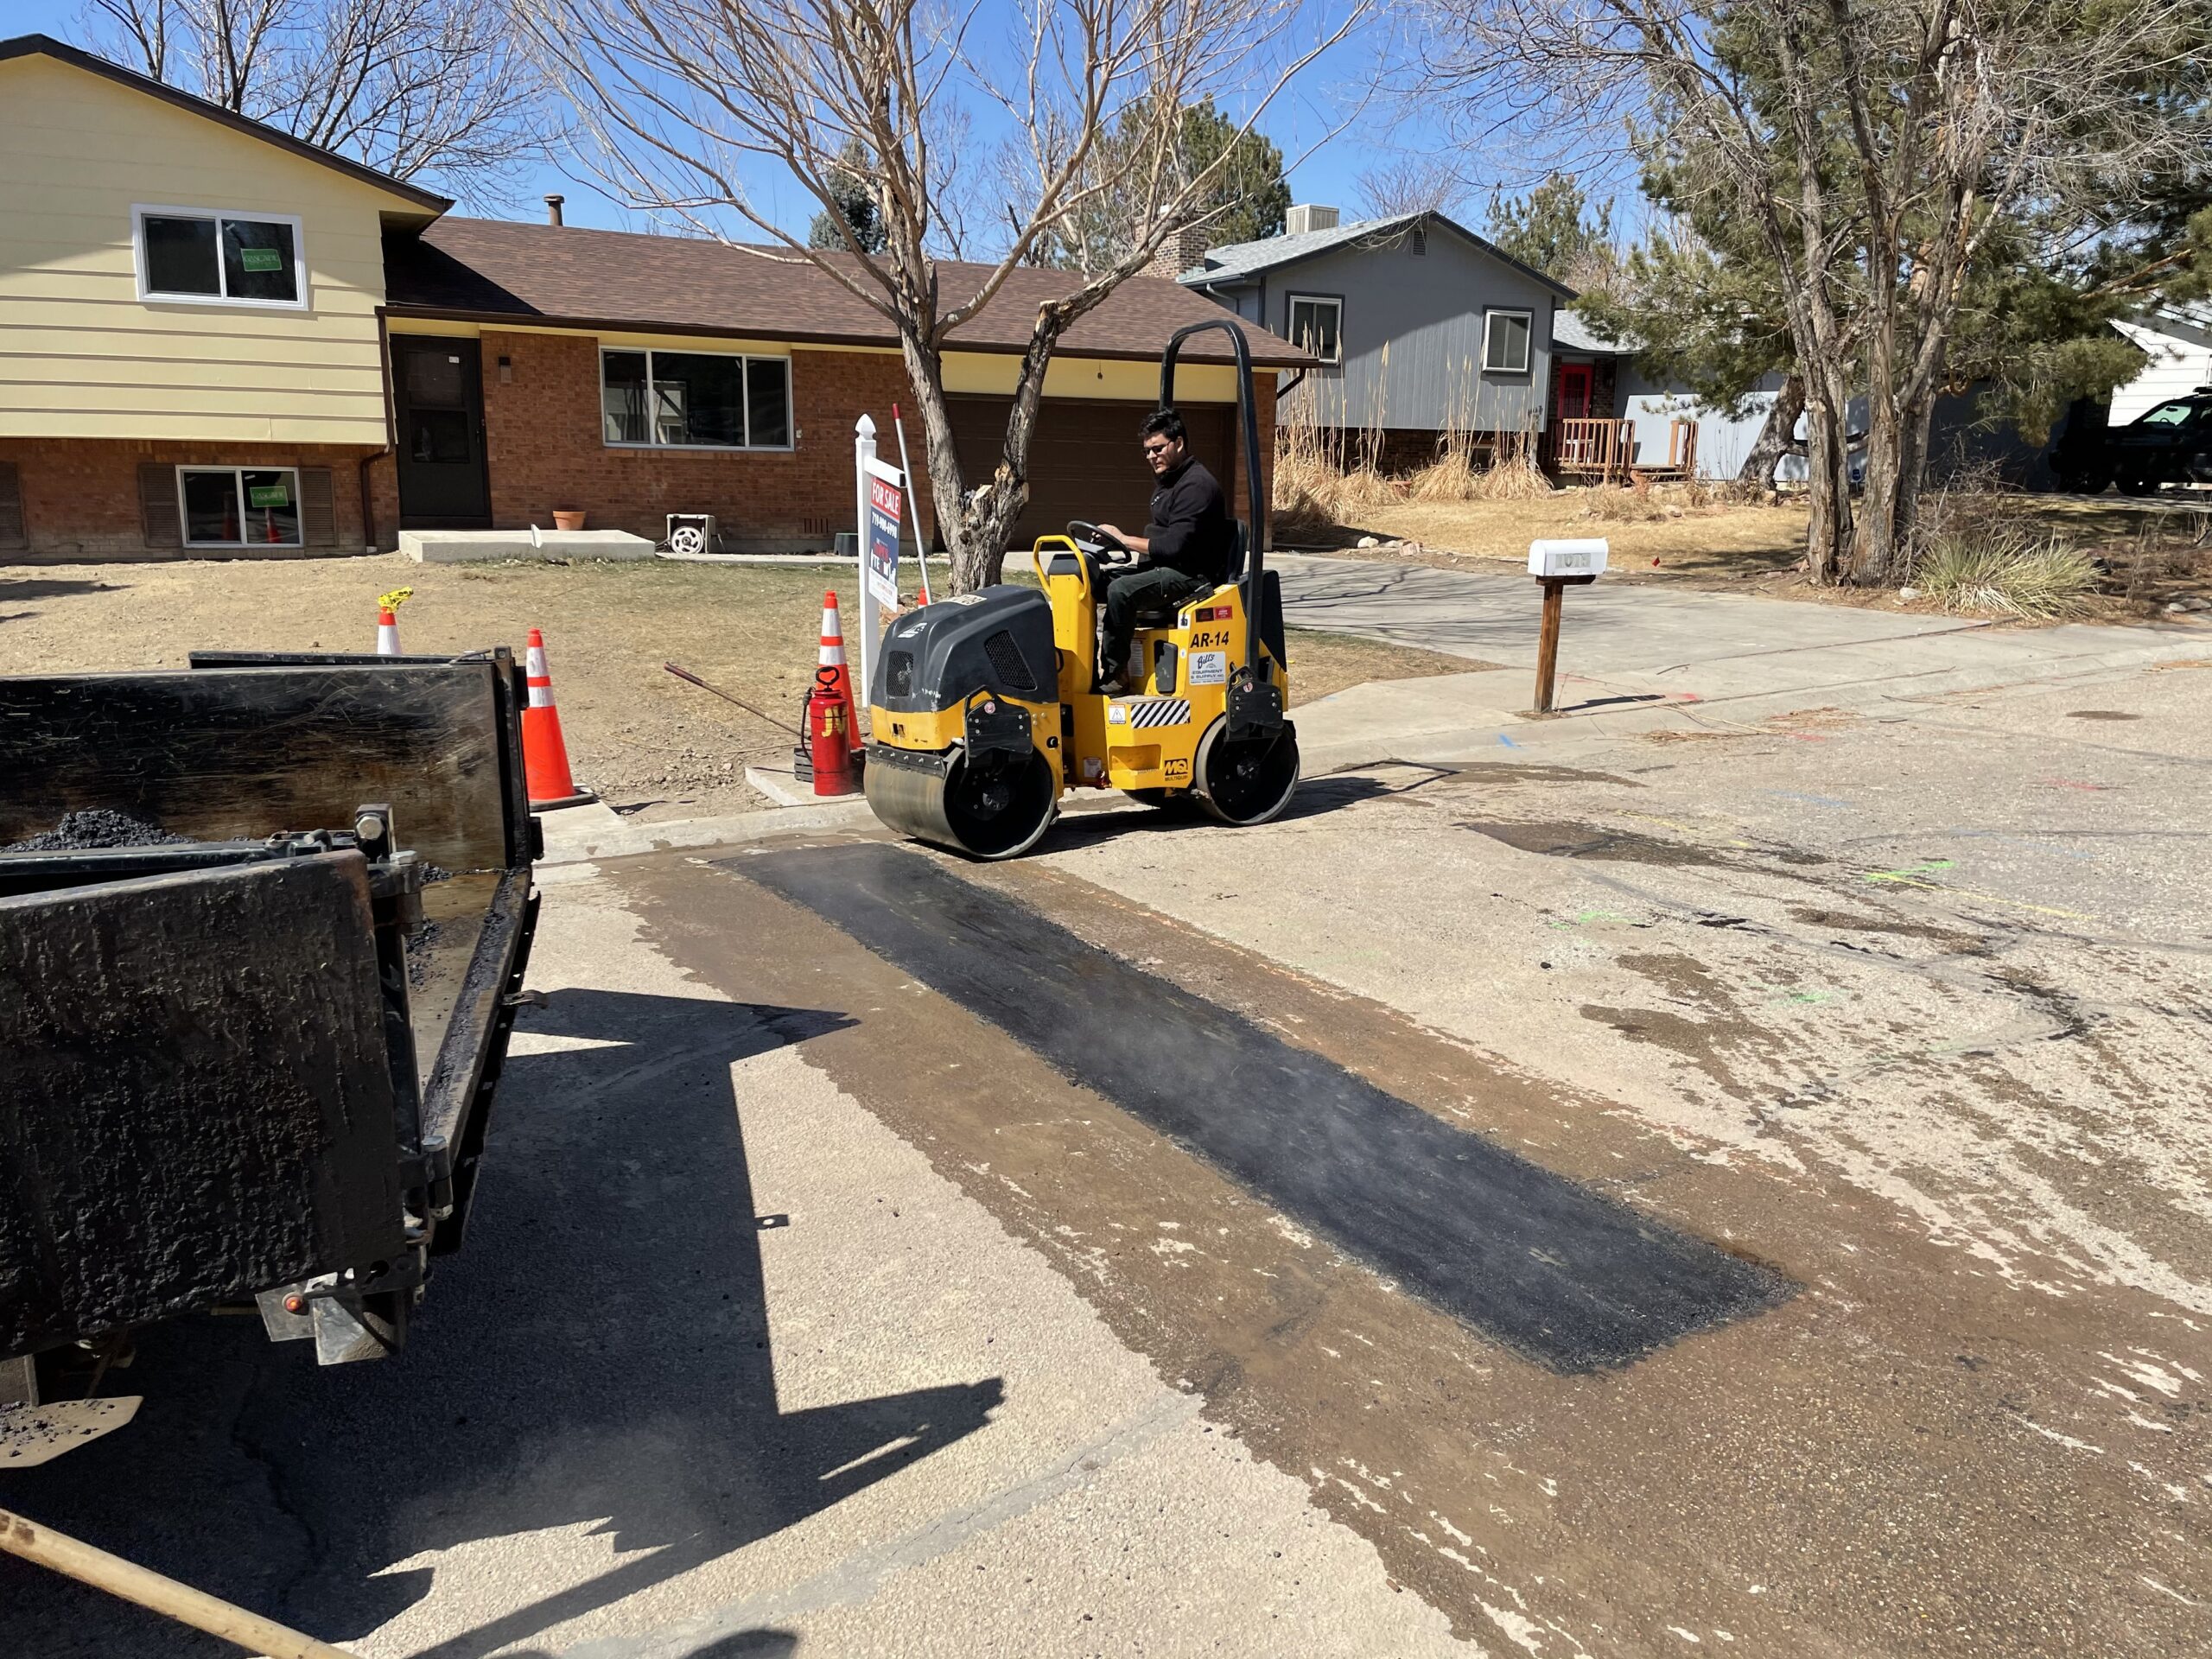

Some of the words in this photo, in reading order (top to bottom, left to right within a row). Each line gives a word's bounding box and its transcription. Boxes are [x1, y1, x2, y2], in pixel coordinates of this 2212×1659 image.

[872, 482, 883, 505] FOR
[885, 489, 899, 515] SALE
[1190, 631, 1230, 648] AR-14
[1198, 654, 1215, 670] Bill's
[1165, 759, 1188, 775] MQ
